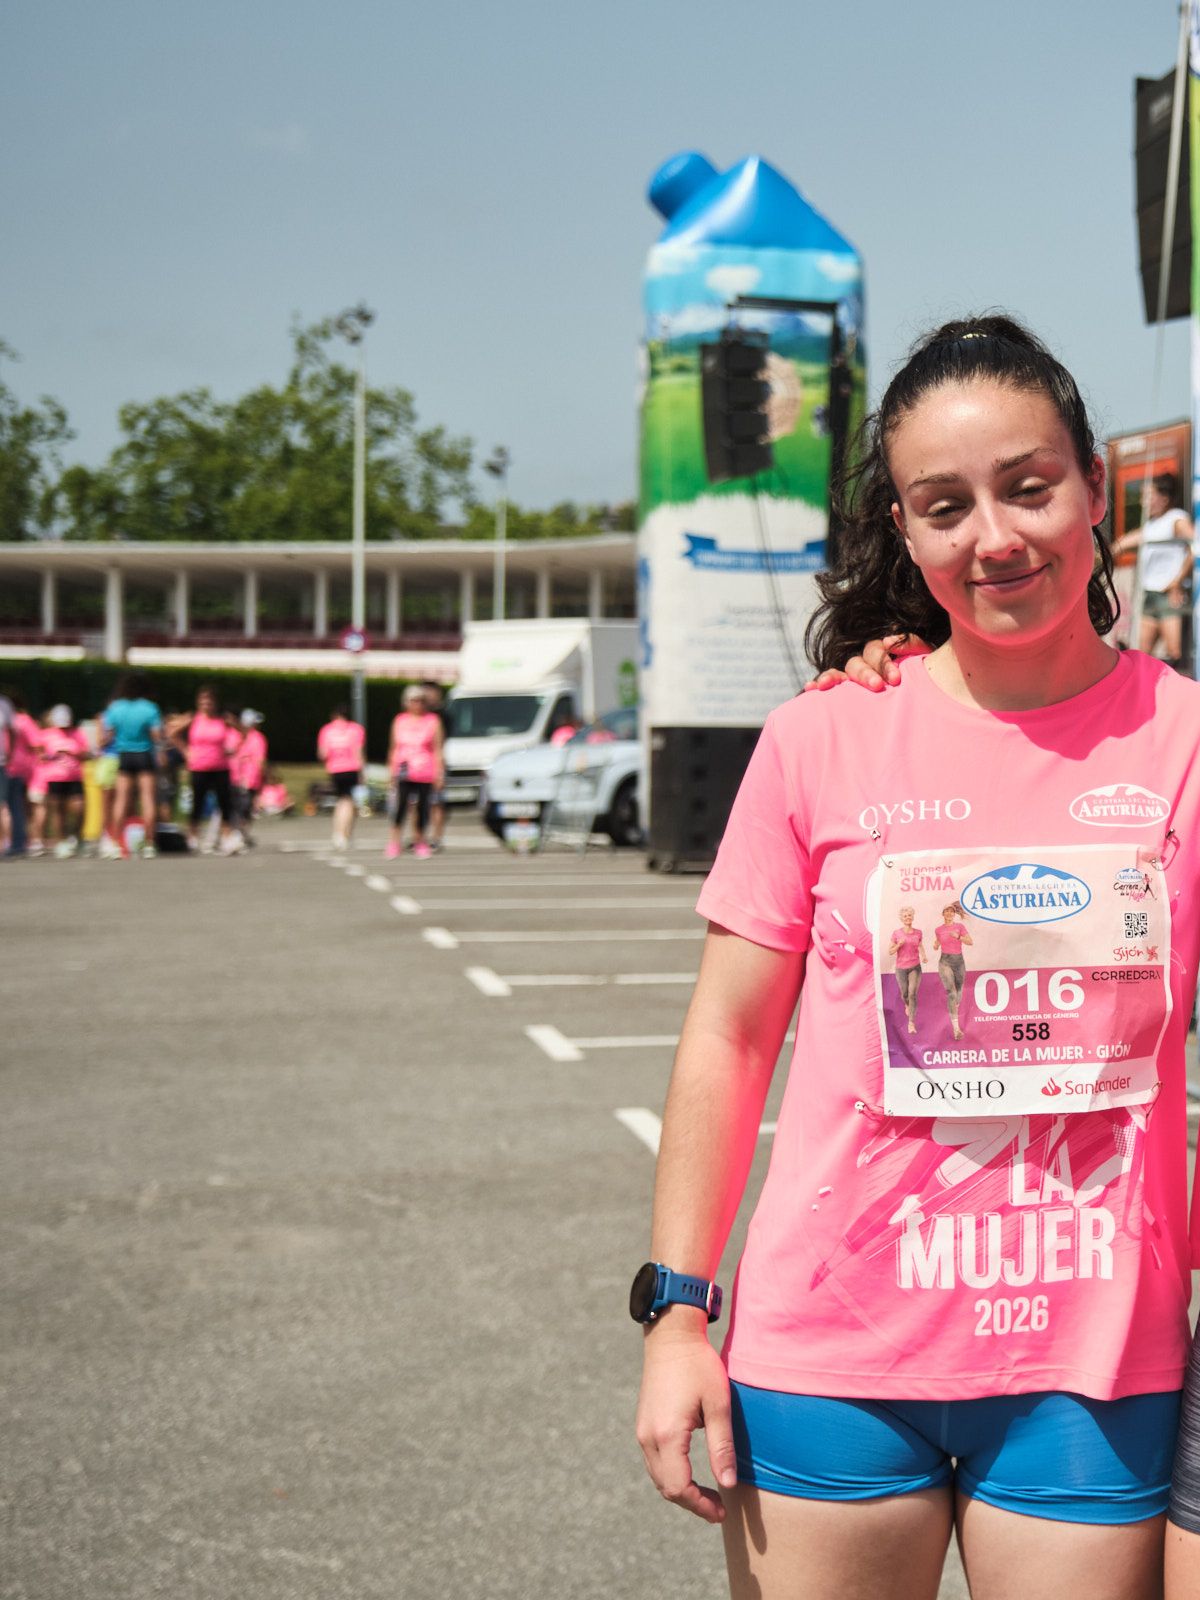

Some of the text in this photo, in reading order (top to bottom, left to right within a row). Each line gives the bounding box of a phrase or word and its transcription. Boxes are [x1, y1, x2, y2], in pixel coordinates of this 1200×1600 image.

[859, 798, 971, 830] OYSHO
[1078, 801, 1164, 817] ASTURIANA
[900, 876, 955, 892] SUMA
[971, 886, 1082, 910] ASTURIANA
[1091, 970, 1160, 981] CORREDORA
[974, 969, 1085, 1014] 016
[974, 1015, 1008, 1023] TELÉFONO
[1012, 1022, 1050, 1041] 558
[923, 1041, 1131, 1065] CARRERA DE LA MUJER GIJÓN
[917, 1076, 1131, 1099] OYSHO Santander
[1008, 1115, 1075, 1207] LA
[896, 1206, 1116, 1290] MUJER
[974, 1295, 1049, 1336] 2026
